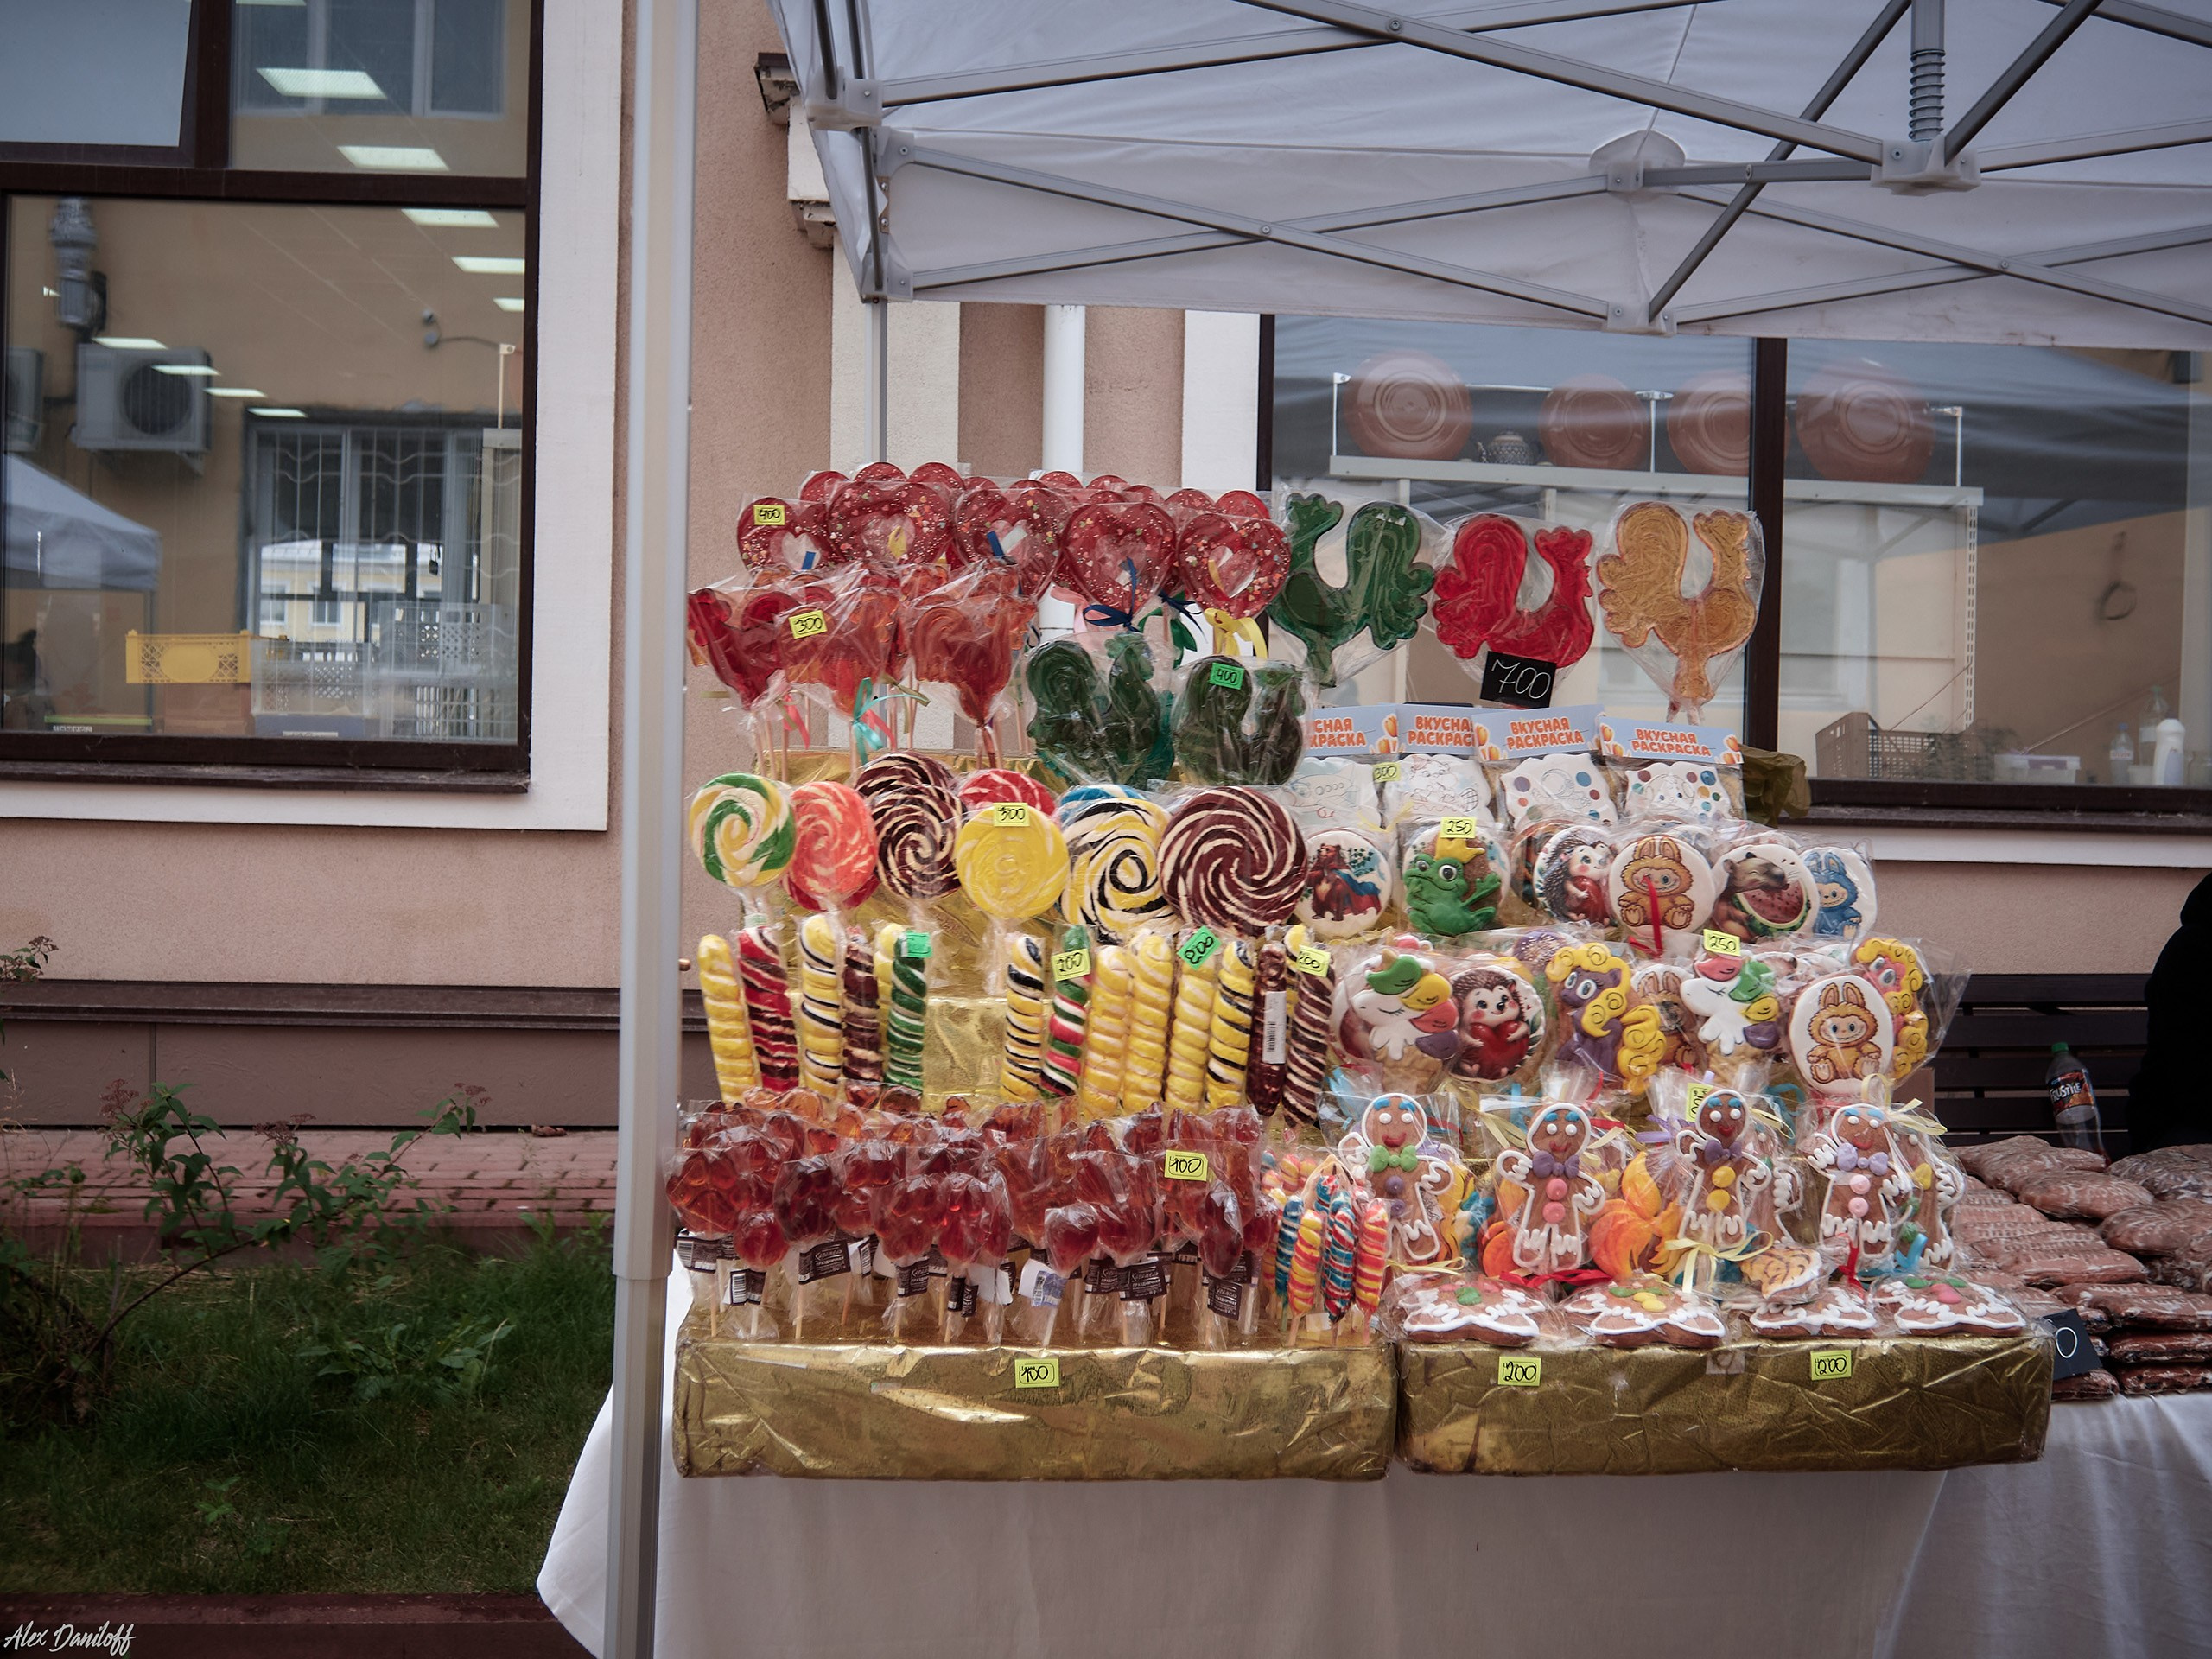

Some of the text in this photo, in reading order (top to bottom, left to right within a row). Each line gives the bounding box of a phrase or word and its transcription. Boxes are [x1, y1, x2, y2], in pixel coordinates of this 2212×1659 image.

[758, 508, 781, 520] 400
[794, 617, 823, 632] 300
[1217, 668, 1237, 683] 400
[1491, 659, 1551, 699] 700
[1415, 716, 1473, 732] ВКУСНА
[1510, 717, 1570, 735] ВКУСНАЯ
[1408, 731, 1475, 747] РАСКРАС
[1506, 730, 1583, 750] РАСКРАСКА
[1636, 728, 1697, 744] ВКУСНАЯ
[1631, 740, 1711, 756] РАСКРАСКА
[1446, 819, 1472, 834] 250
[1185, 936, 1214, 964] 200
[1709, 935, 1736, 951] 250
[1057, 951, 1083, 972] 200
[1169, 1158, 1202, 1173] 100
[1021, 1365, 1049, 1382] 100
[1505, 1361, 1536, 1382] 200
[1818, 1357, 1847, 1376] 200
